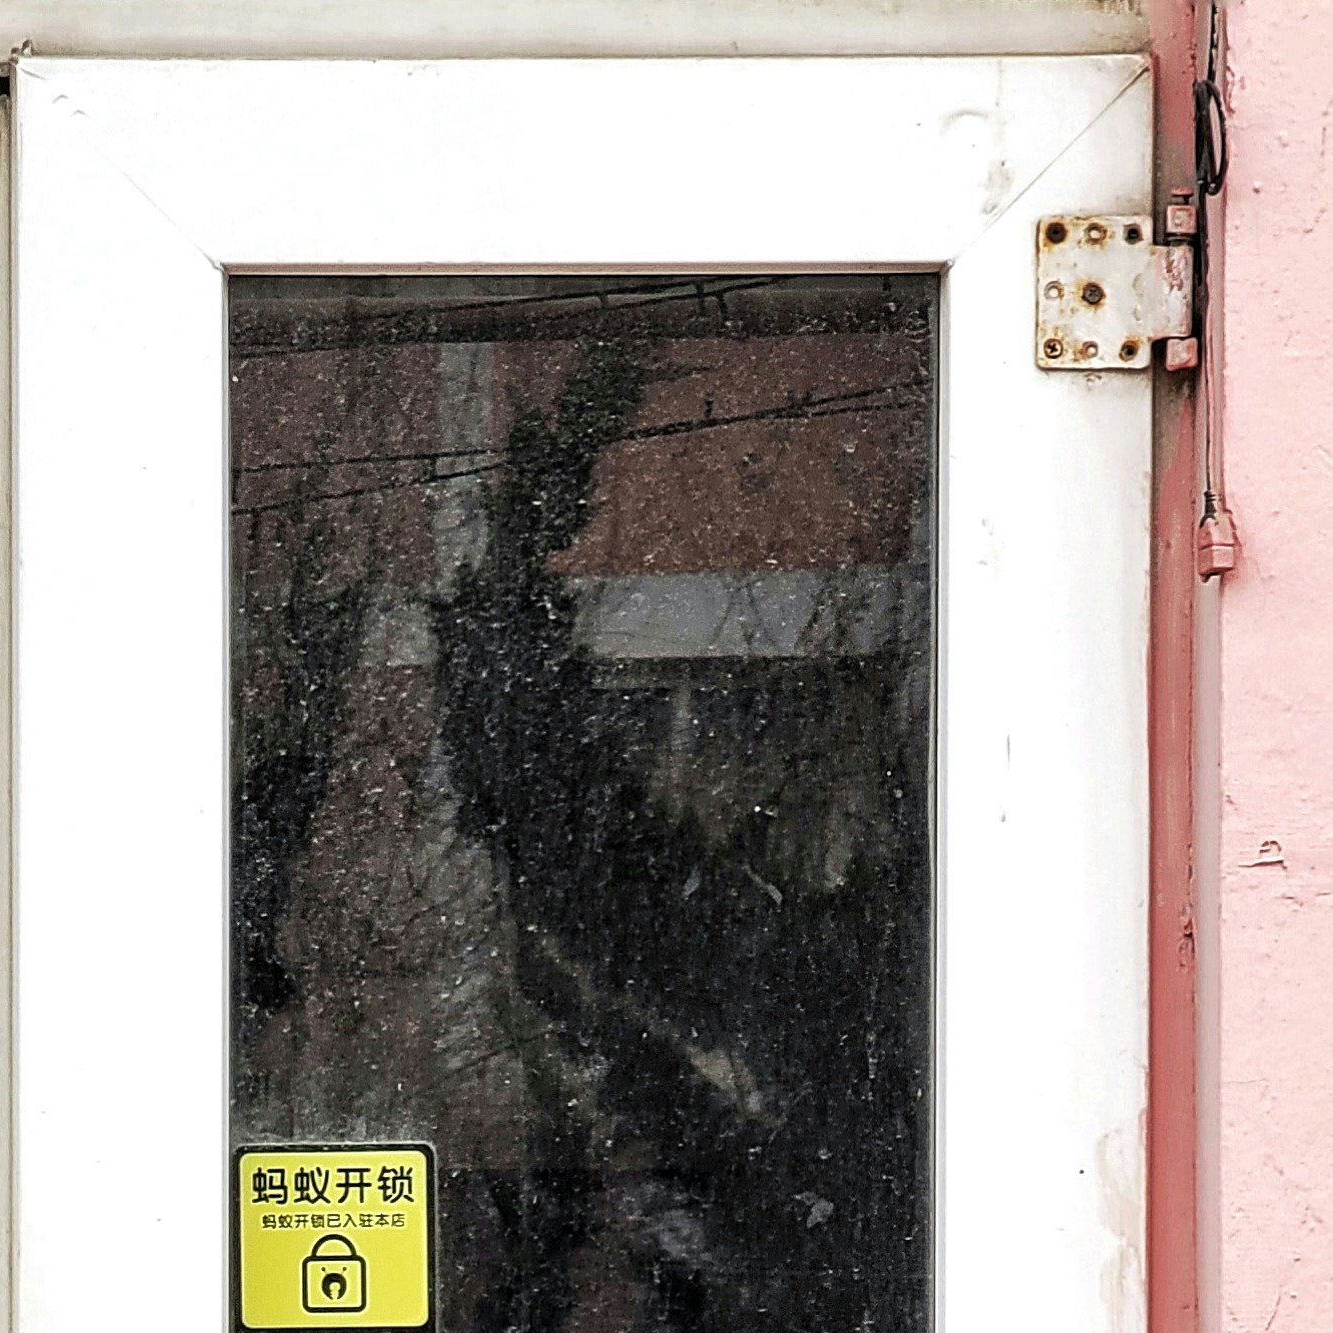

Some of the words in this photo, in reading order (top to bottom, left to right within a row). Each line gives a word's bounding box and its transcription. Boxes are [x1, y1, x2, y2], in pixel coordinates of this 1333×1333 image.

[252, 1166, 415, 1204] 蚂蚁开锁
[262, 1213, 406, 1229] 蚂蚁开锁已入驻本店
